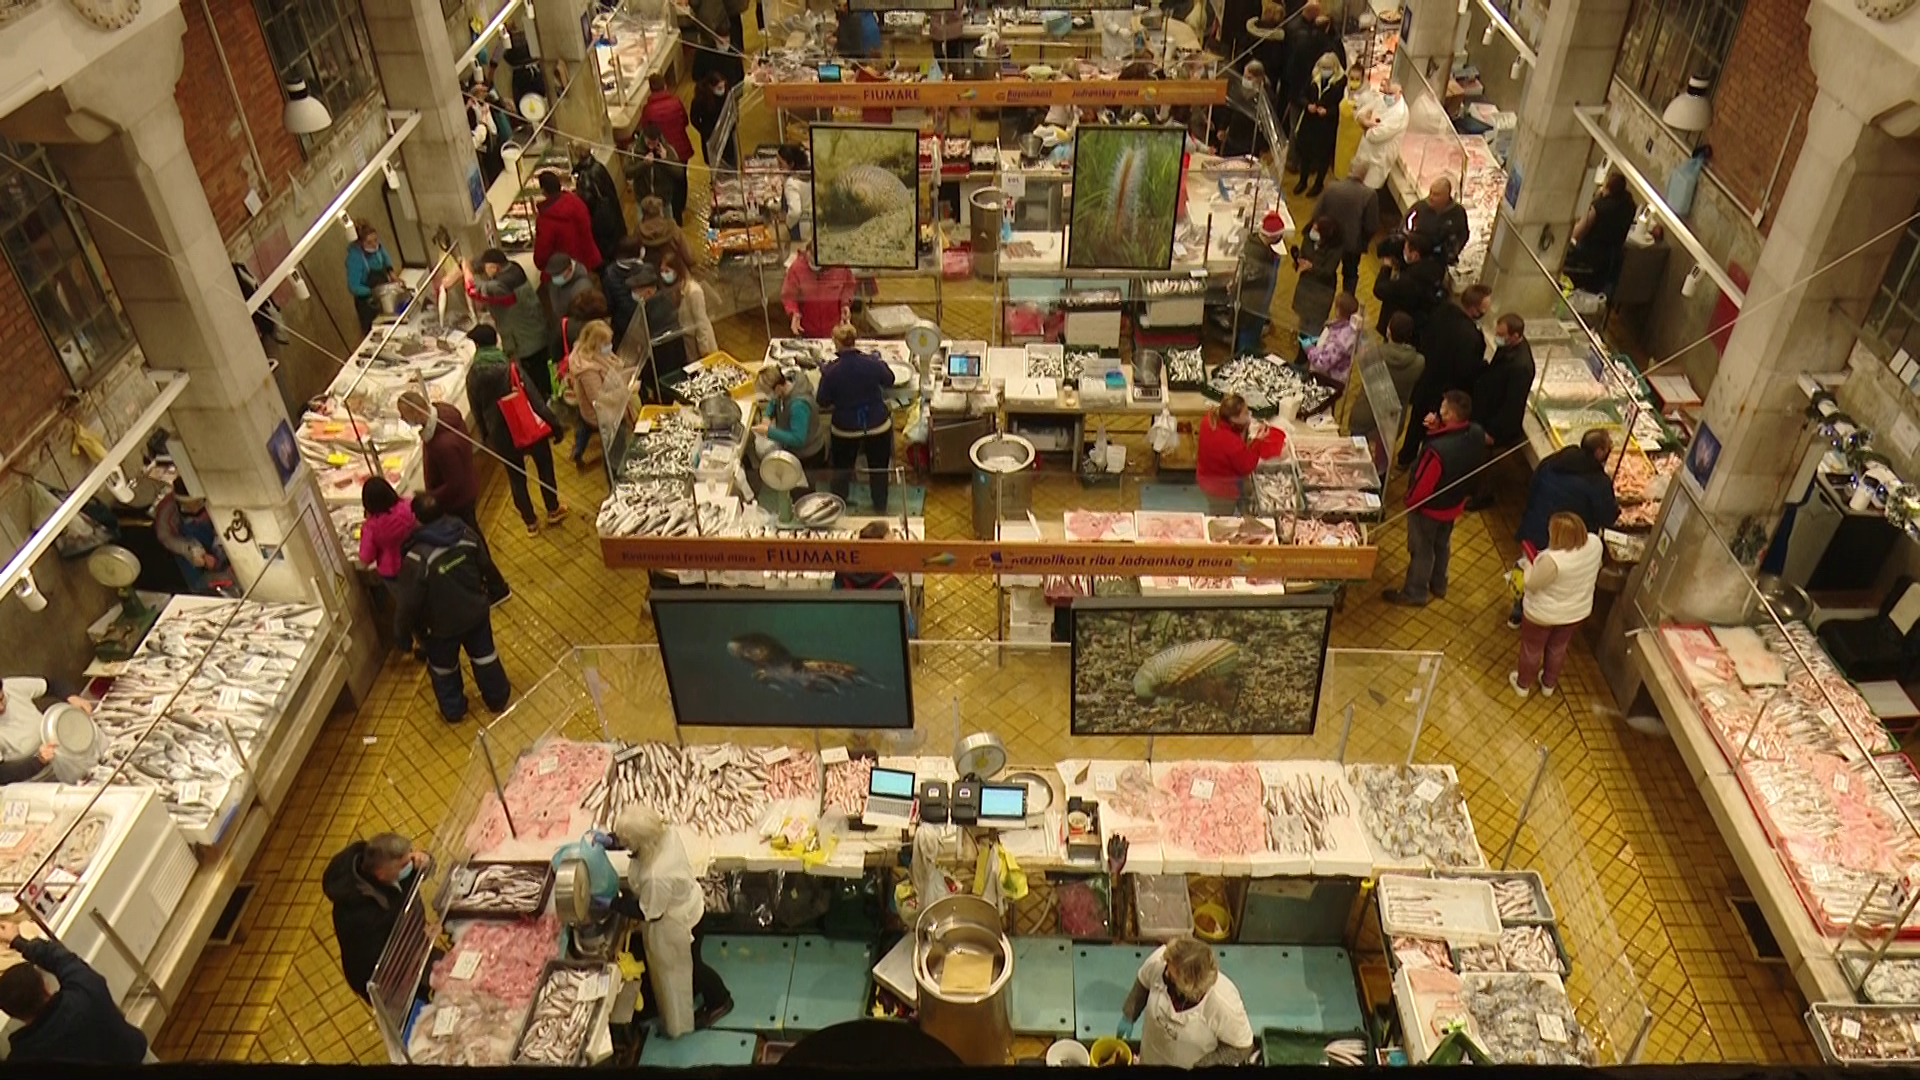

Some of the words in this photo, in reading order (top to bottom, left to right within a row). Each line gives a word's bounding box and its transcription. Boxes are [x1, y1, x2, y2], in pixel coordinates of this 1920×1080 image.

[864, 89, 920, 101] FIUMARE
[684, 552, 724, 565] festival
[766, 548, 861, 565] FIUMARE
[1089, 554, 1116, 566] riba
[1119, 554, 1194, 569] Jadranskog
[1197, 556, 1233, 568] mora
